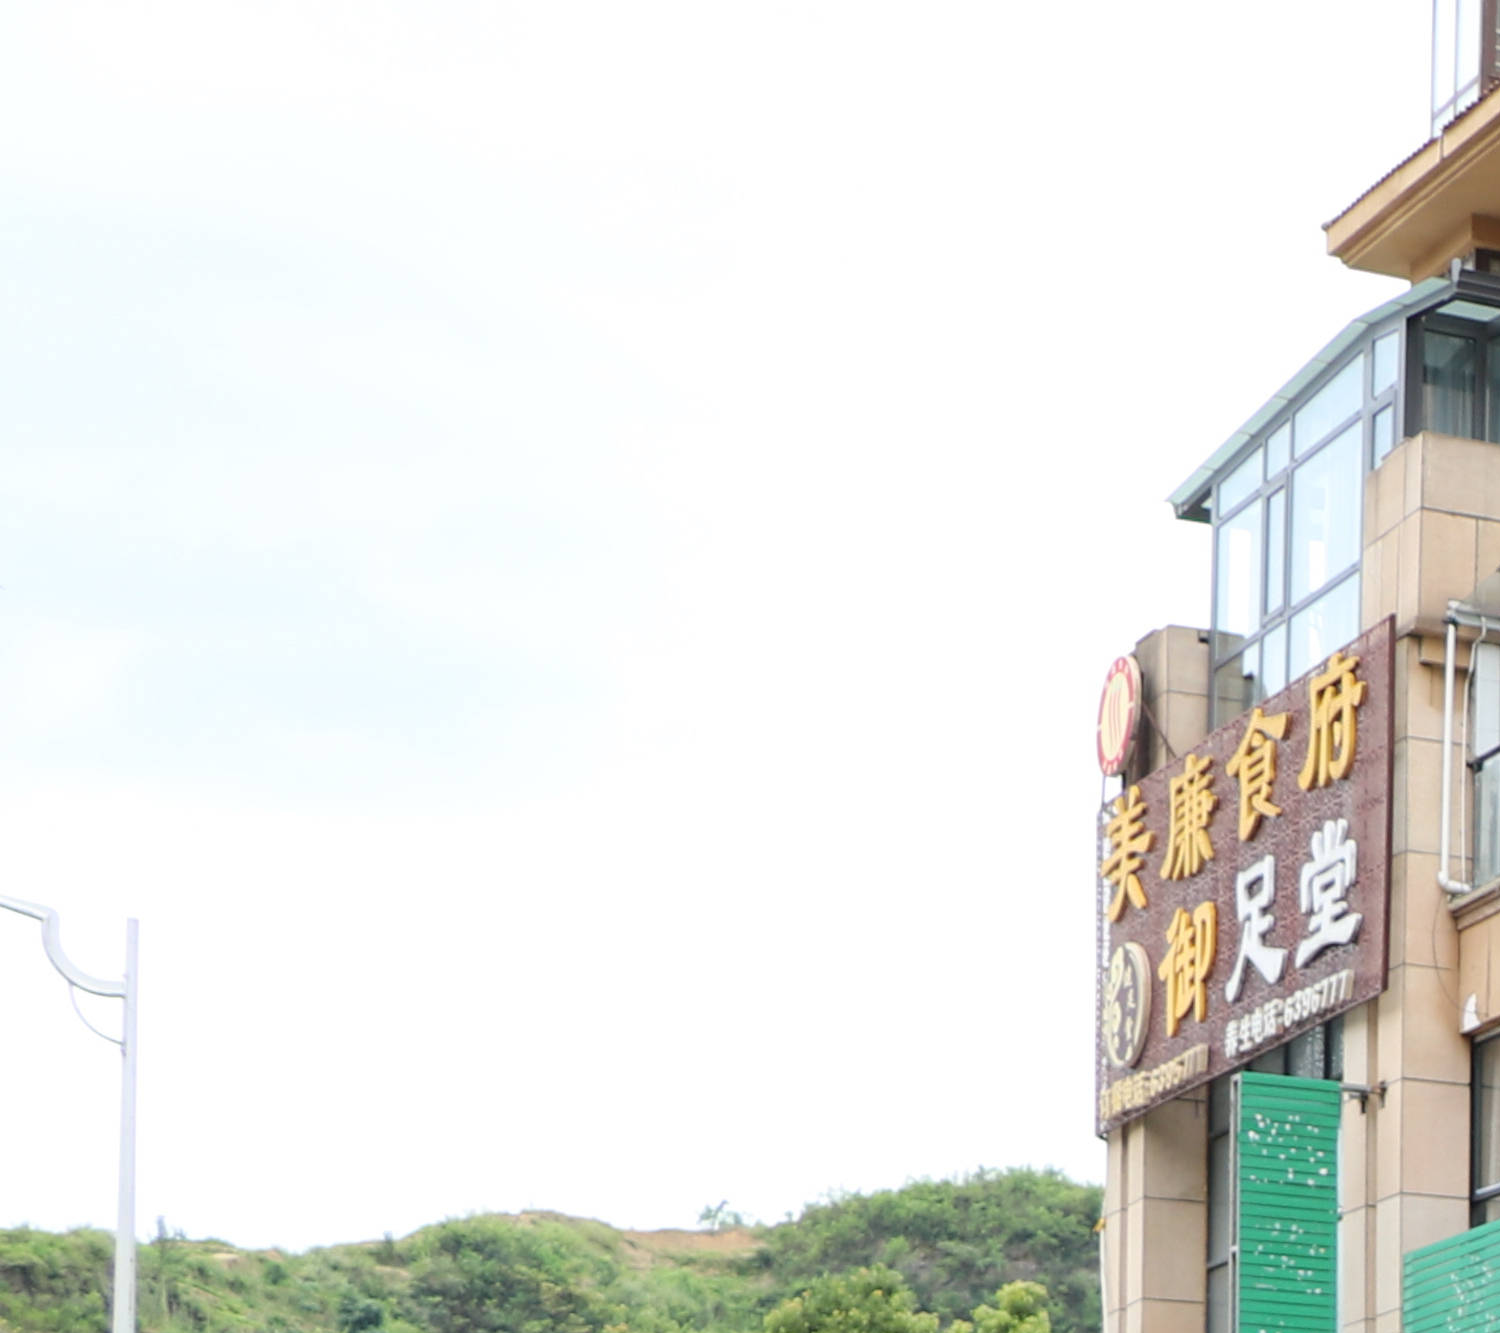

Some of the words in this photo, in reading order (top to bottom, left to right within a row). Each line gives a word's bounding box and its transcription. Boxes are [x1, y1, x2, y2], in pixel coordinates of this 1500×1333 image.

[1101, 652, 1368, 923] 美廉食府
[1158, 818, 1365, 1038] 御足堂
